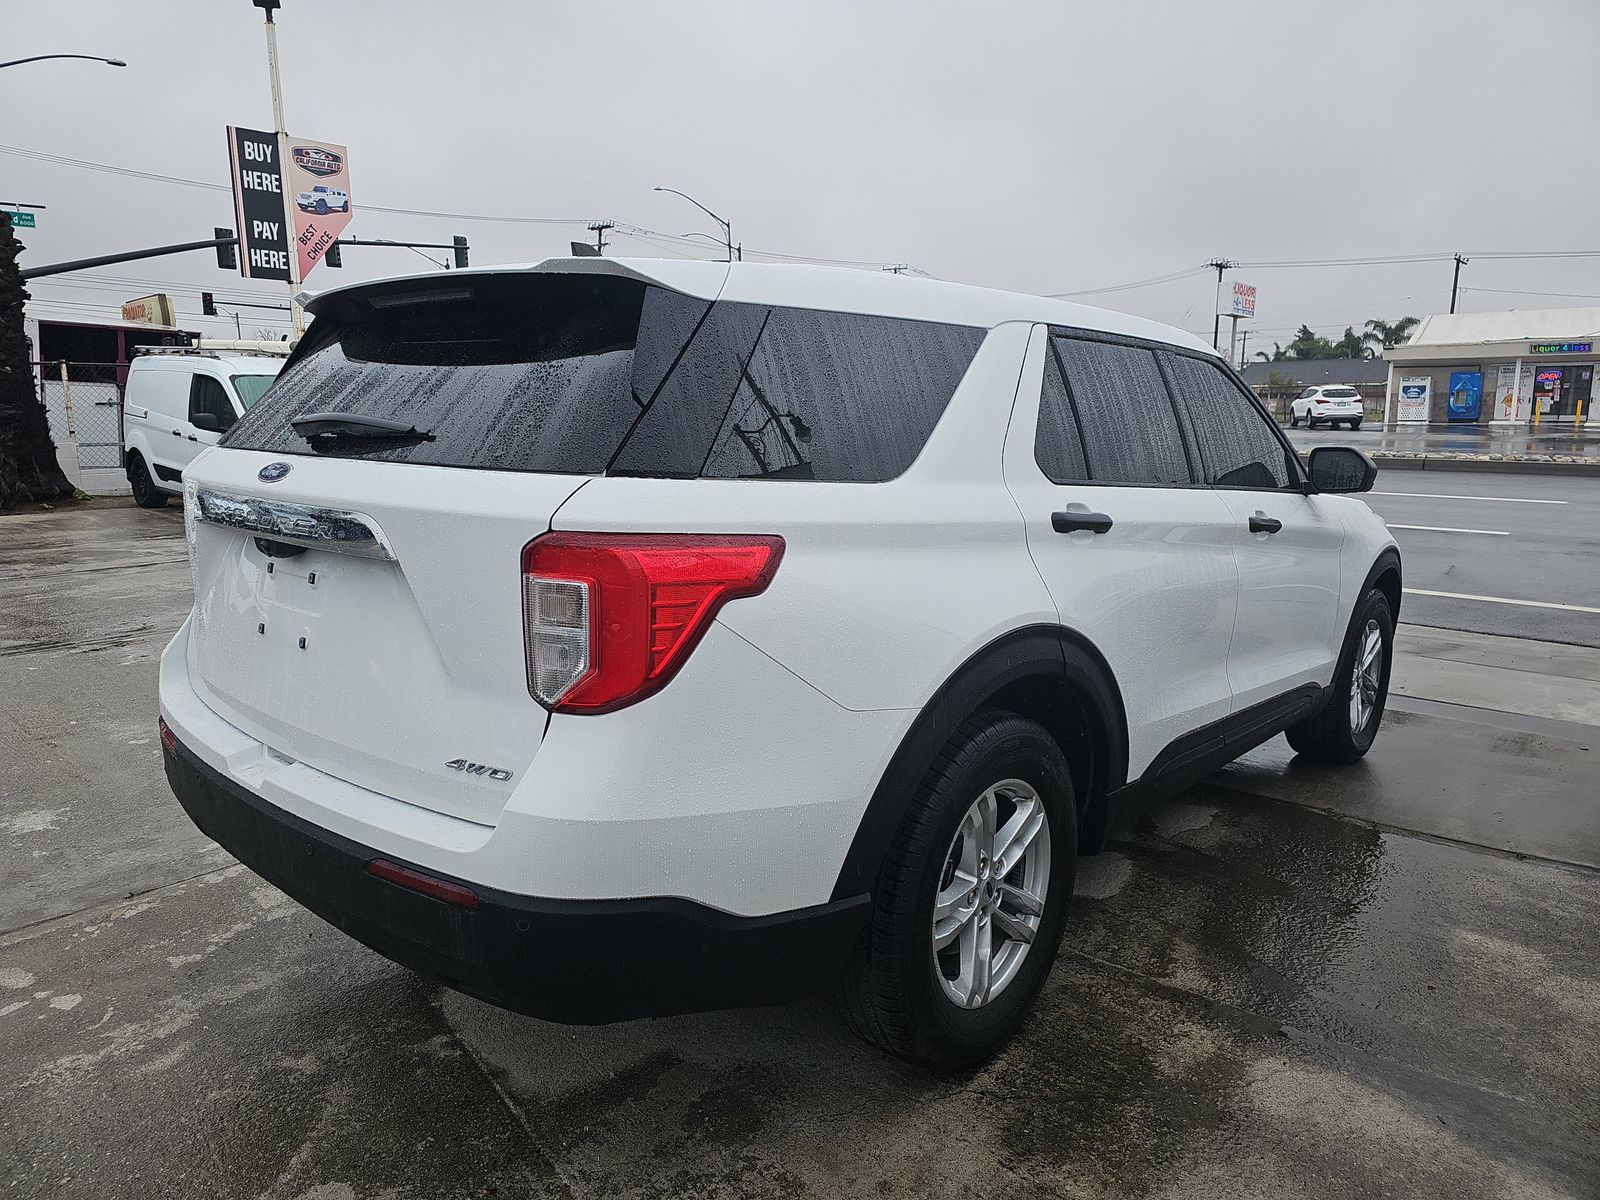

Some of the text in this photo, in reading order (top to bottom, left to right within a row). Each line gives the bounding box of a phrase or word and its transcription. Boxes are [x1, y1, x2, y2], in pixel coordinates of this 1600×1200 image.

[243, 140, 273, 163] BUY
[295, 157, 327, 168] CALIFORNIA
[326, 161, 341, 171] AUTO
[242, 169, 281, 193] HERE
[252, 220, 279, 241] PAY
[298, 223, 318, 246] BEST
[306, 230, 333, 261] CHOICE
[250, 248, 288, 270] HERE
[1233, 282, 1256, 298] LIQUOR
[1242, 298, 1255, 310] LESS
[445, 758, 513, 781] 4WD
